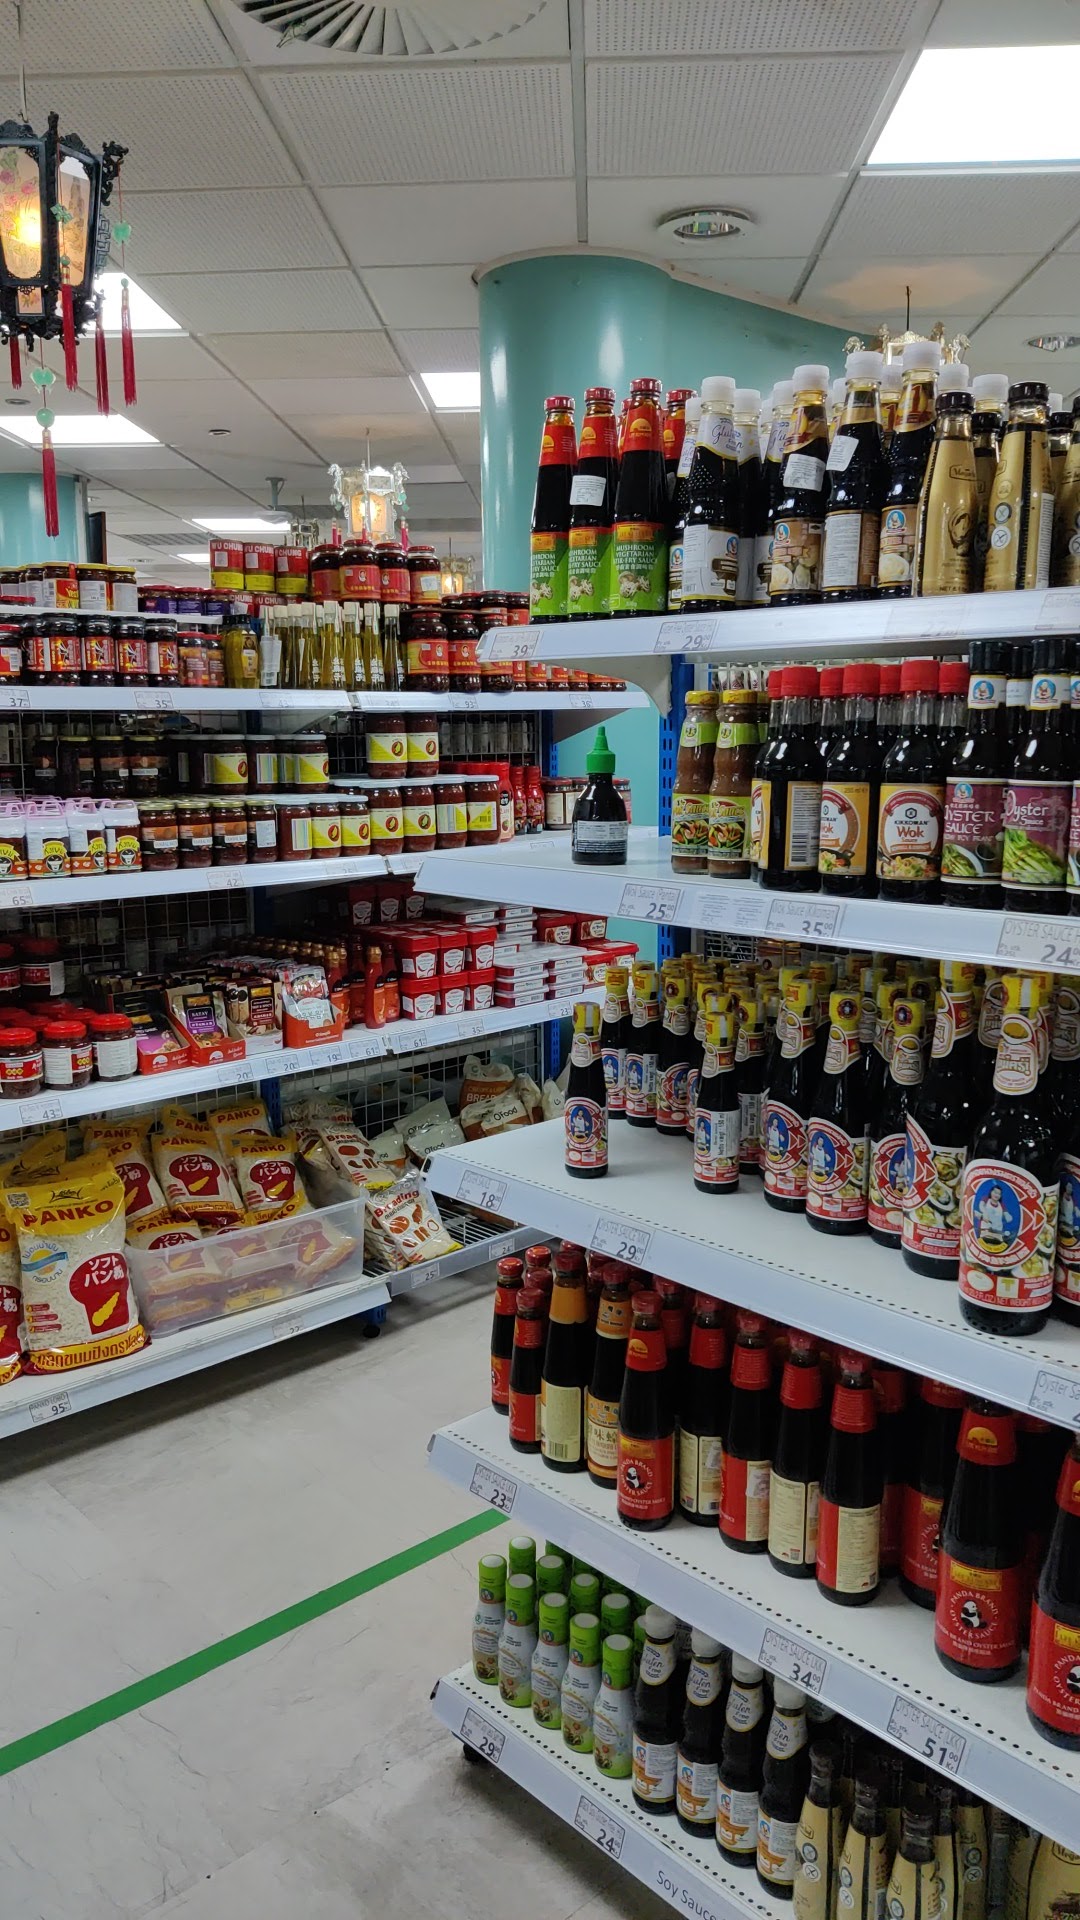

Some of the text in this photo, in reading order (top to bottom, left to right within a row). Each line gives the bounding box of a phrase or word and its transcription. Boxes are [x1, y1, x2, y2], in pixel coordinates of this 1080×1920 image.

[615, 544, 655, 552] MUSHROOM
[615, 551, 655, 559] VEGETARIAN
[681, 634, 703, 651] 29
[513, 644, 529, 658] 39
[9, 698, 22, 707] 37
[154, 700, 167, 708] 35
[1005, 789, 1049, 821] Oyster
[945, 823, 983, 835] SAUCE
[1020, 816, 1044, 826] Sauce
[897, 826, 925, 838] Wok
[227, 879, 239, 887] 42
[12, 896, 26, 905] 65
[638, 886, 656, 899] Sauce
[646, 902, 667, 920] 25
[786, 902, 805, 916] Sauce
[802, 920, 823, 936] 35
[1004, 920, 1073, 942] OYSTER SAUCE
[1040, 943, 1073, 966] 24
[561, 1007, 569, 1016] 23
[327, 1054, 337, 1063] 19
[284, 1062, 294, 1072] 20
[42, 1109, 56, 1119] 43
[217, 1108, 260, 1123] PANKO
[241, 1143, 286, 1154] PANKO
[178, 1162, 213, 1172] パン粉
[259, 1167, 292, 1176] パン粉
[480, 1191, 496, 1208] 18
[22, 1200, 114, 1227] PANKO
[616, 1241, 637, 1260] 29
[88, 1255, 119, 1271] ソフト
[84, 1264, 125, 1287] パン粉
[425, 1270, 435, 1281] 25
[1039, 1373, 1068, 1395] Oyster
[51, 1402, 65, 1415] 95
[490, 1488, 507, 1509] 23
[950, 1590, 999, 1616] PANDA BRAND
[949, 1608, 998, 1640] OYSTER SAUCE
[765, 1630, 789, 1654] OYSTER
[789, 1643, 809, 1666] SAUCE
[789, 1662, 812, 1688] 34
[1033, 1686, 1080, 1714] PANDA BRAND
[895, 1699, 921, 1725] OYSTER
[921, 1714, 944, 1740] SAUCE
[479, 1736, 495, 1757] 29
[922, 1737, 948, 1766] 51
[597, 1828, 615, 1852] 24
[656, 1870, 717, 1920] Soy Sauce
